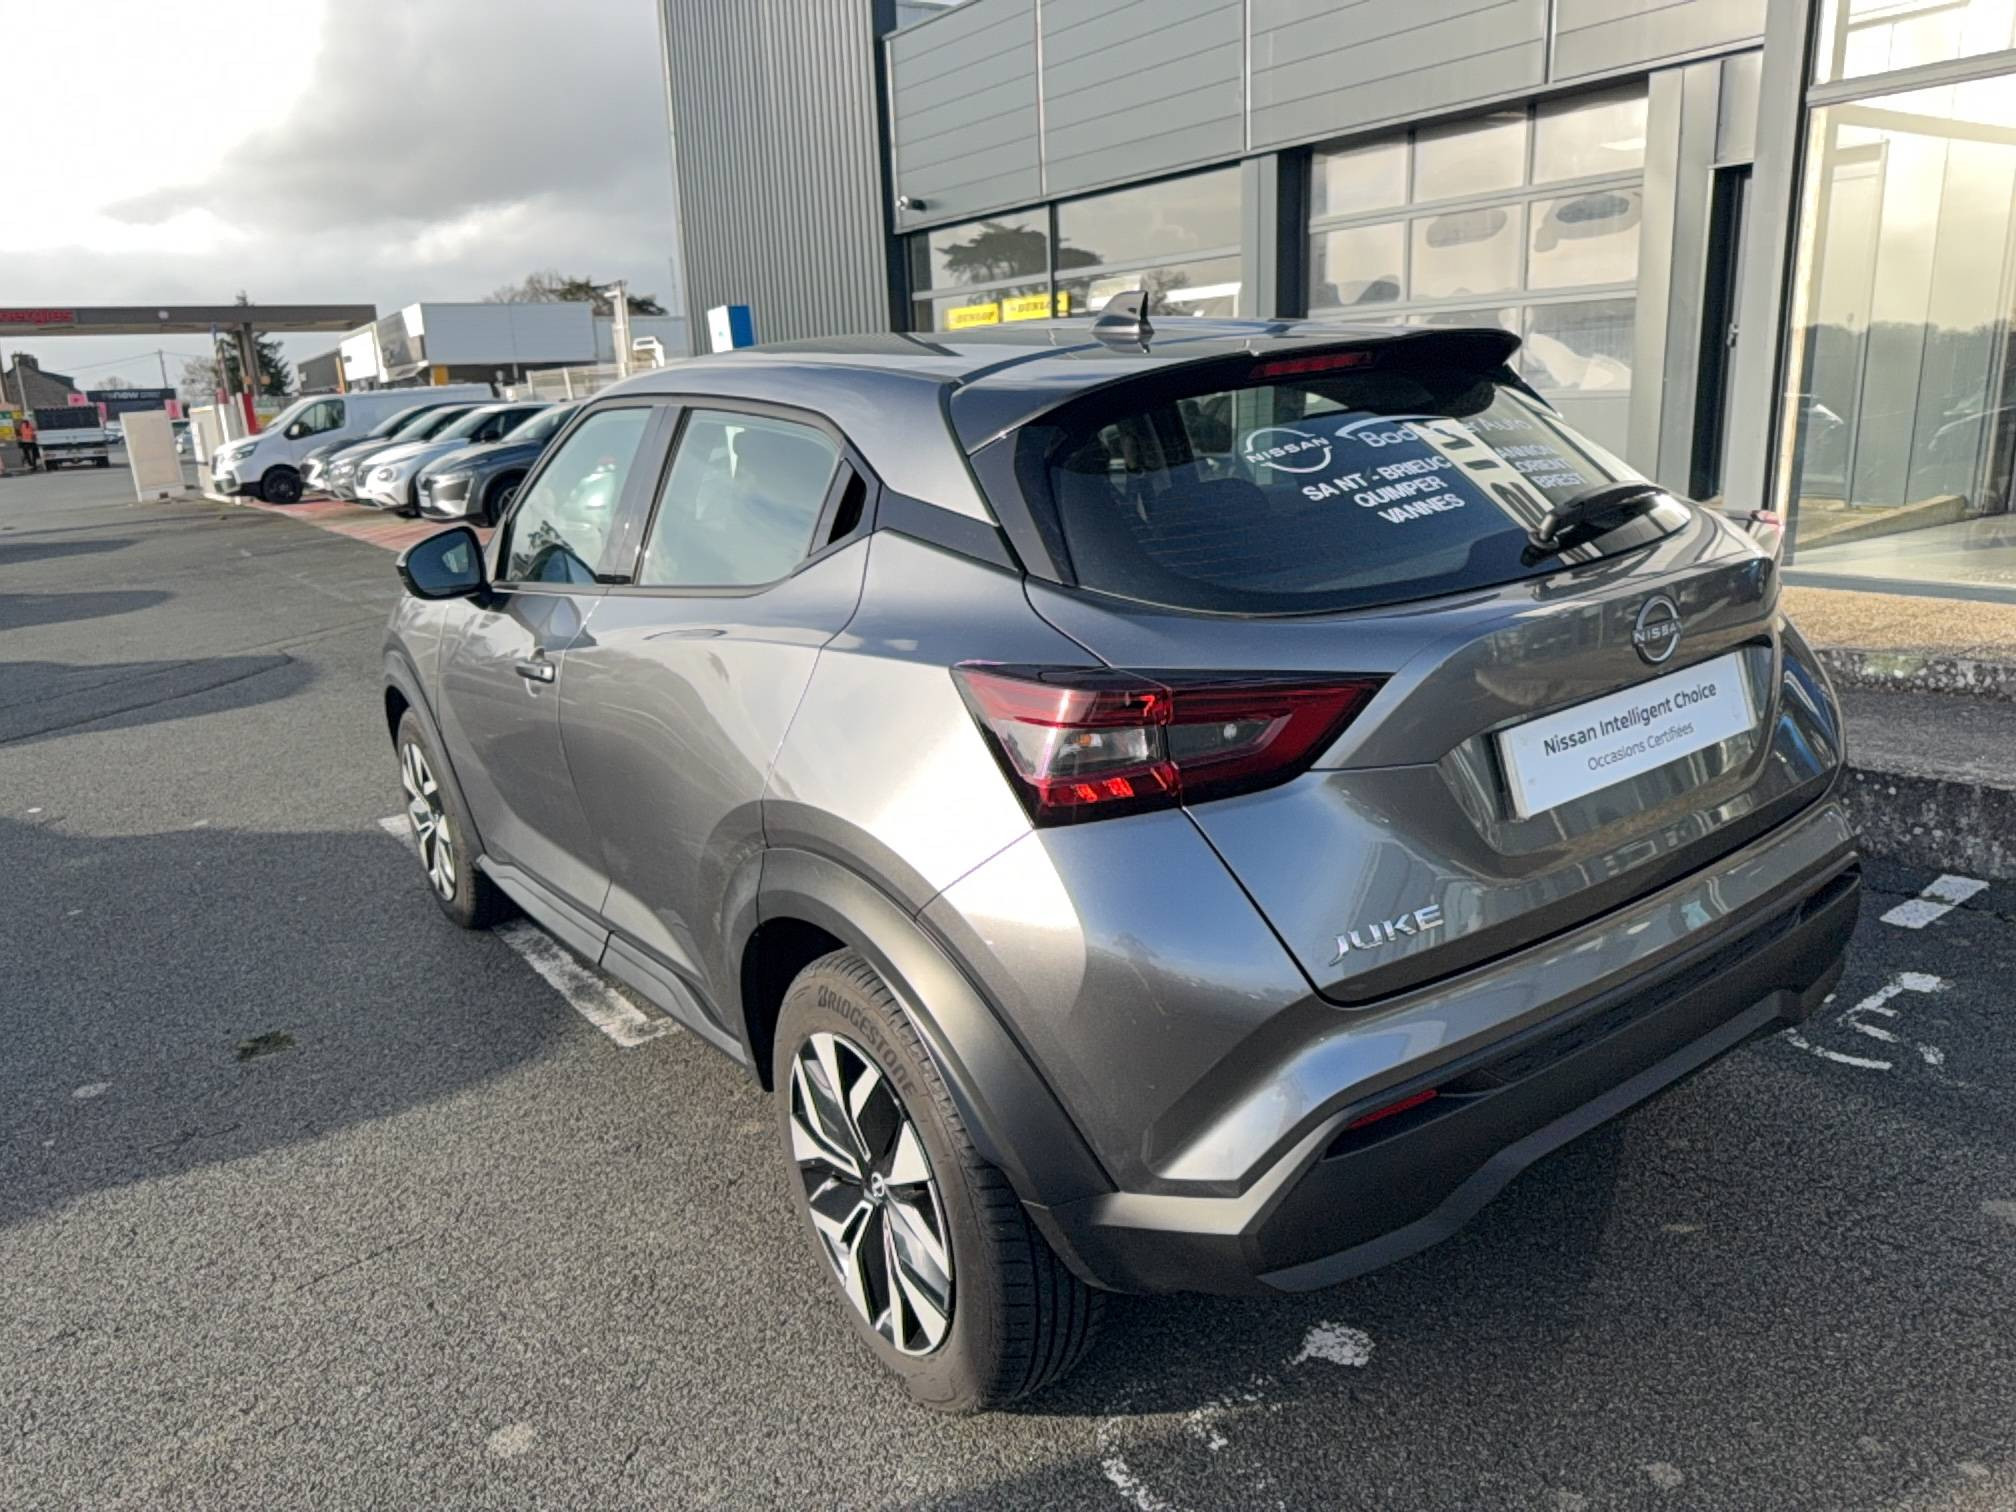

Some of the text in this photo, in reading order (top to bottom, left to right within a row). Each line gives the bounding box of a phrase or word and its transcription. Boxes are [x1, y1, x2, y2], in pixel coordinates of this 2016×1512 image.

[1246, 437, 1330, 463] NISSAN
[1353, 475, 1448, 508] QUIMPER
[1377, 493, 1466, 524] VANNES
[1543, 681, 1717, 756] Nissan Intelligent Choice
[1586, 739, 1647, 771] Occasions
[1328, 903, 1444, 967] JUKE
[817, 985, 917, 1098] BRIDGESTONE
